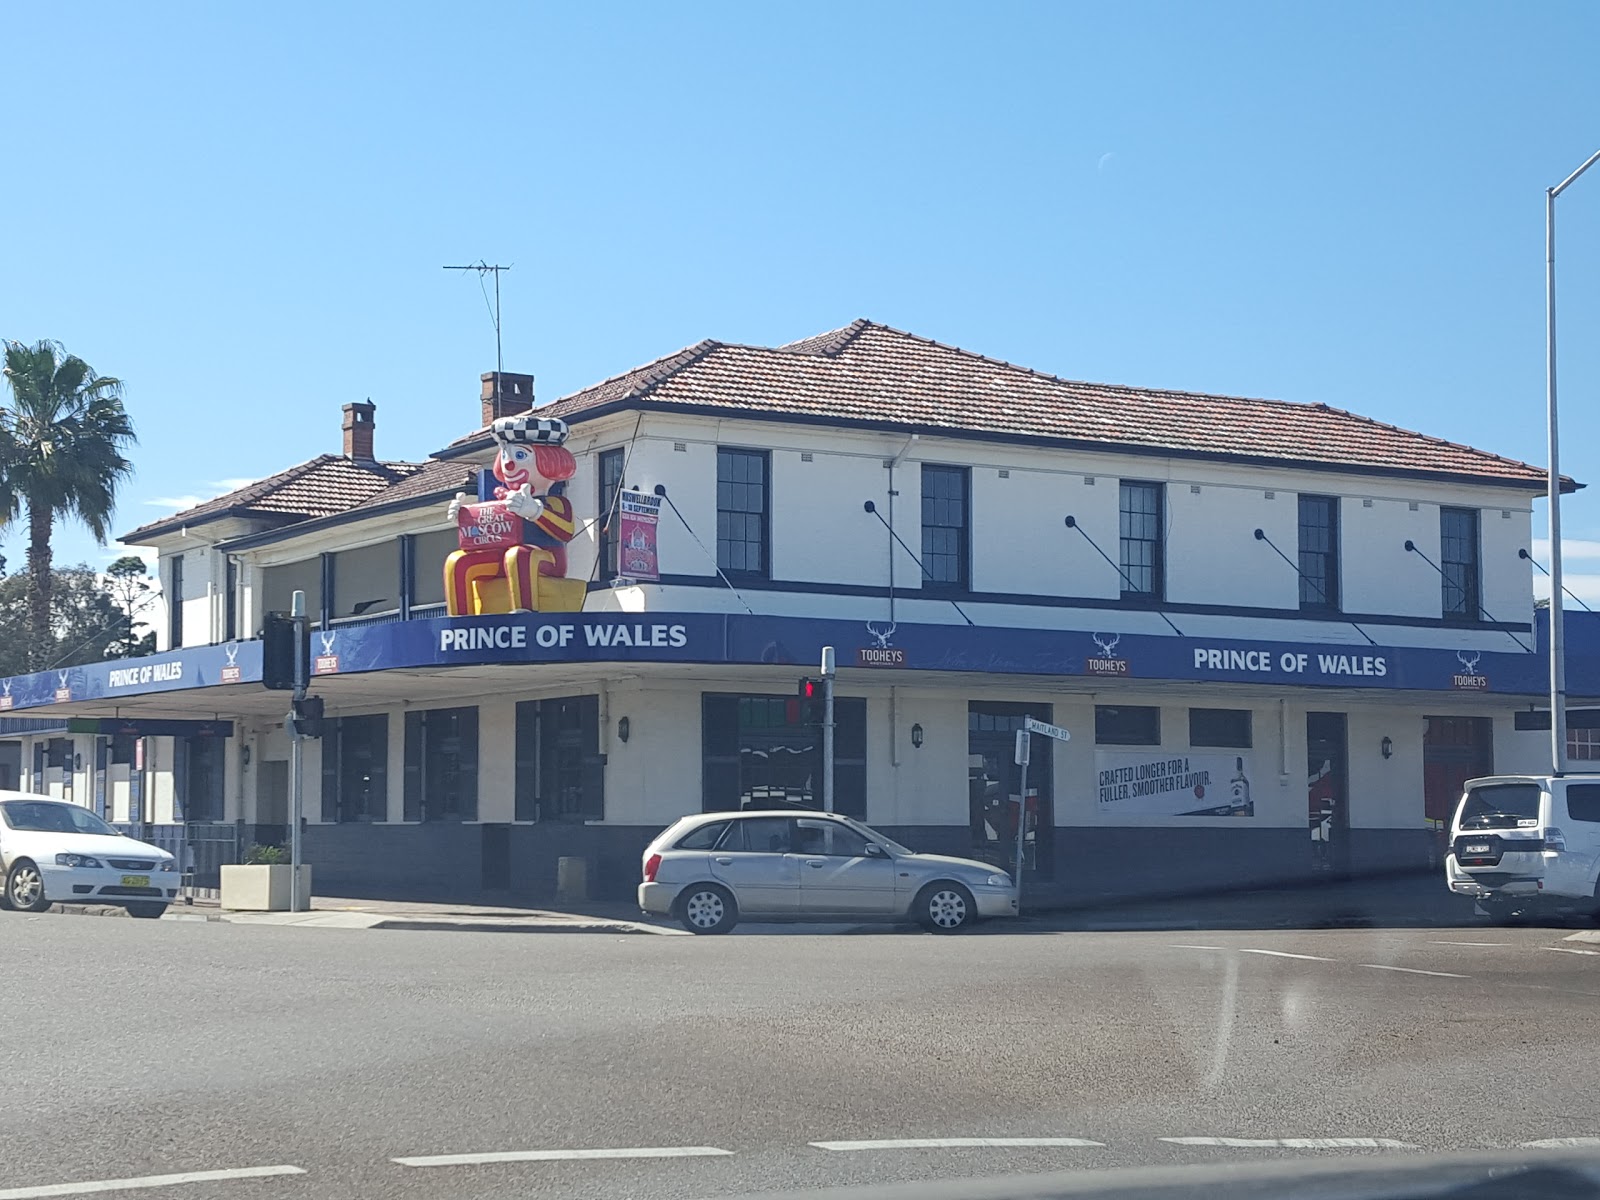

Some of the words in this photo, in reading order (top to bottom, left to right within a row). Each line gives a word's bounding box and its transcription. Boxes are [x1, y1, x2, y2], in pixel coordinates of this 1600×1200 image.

[477, 513, 506, 525] GREAT
[479, 507, 495, 516] THE
[473, 534, 503, 546] CIRCUS
[440, 626, 527, 651] PRINCE
[535, 625, 574, 647] OF
[583, 624, 687, 647] WALES
[860, 649, 903, 662] TOOHEYS
[1194, 648, 1271, 672] PRINCE
[1280, 652, 1308, 673] OF
[1318, 654, 1387, 677] WALES
[1087, 659, 1126, 672] TOOHEYS
[109, 667, 140, 688] PRINCE
[140, 665, 153, 684] OF
[153, 661, 182, 682] WALES
[1453, 674, 1487, 687] TOOHEYS
[1031, 720, 1059, 737] MAITLAND
[1060, 729, 1068, 739] ST
[1099, 766, 1134, 787] CRAFTED
[1135, 761, 1166, 779] LONGER
[1167, 759, 1183, 775] FOR
[1184, 757, 1190, 772] A
[1099, 784, 1131, 804] FULLER,
[1132, 775, 1175, 798] SMOOTHER
[1176, 770, 1212, 791] FLAVOUR.
